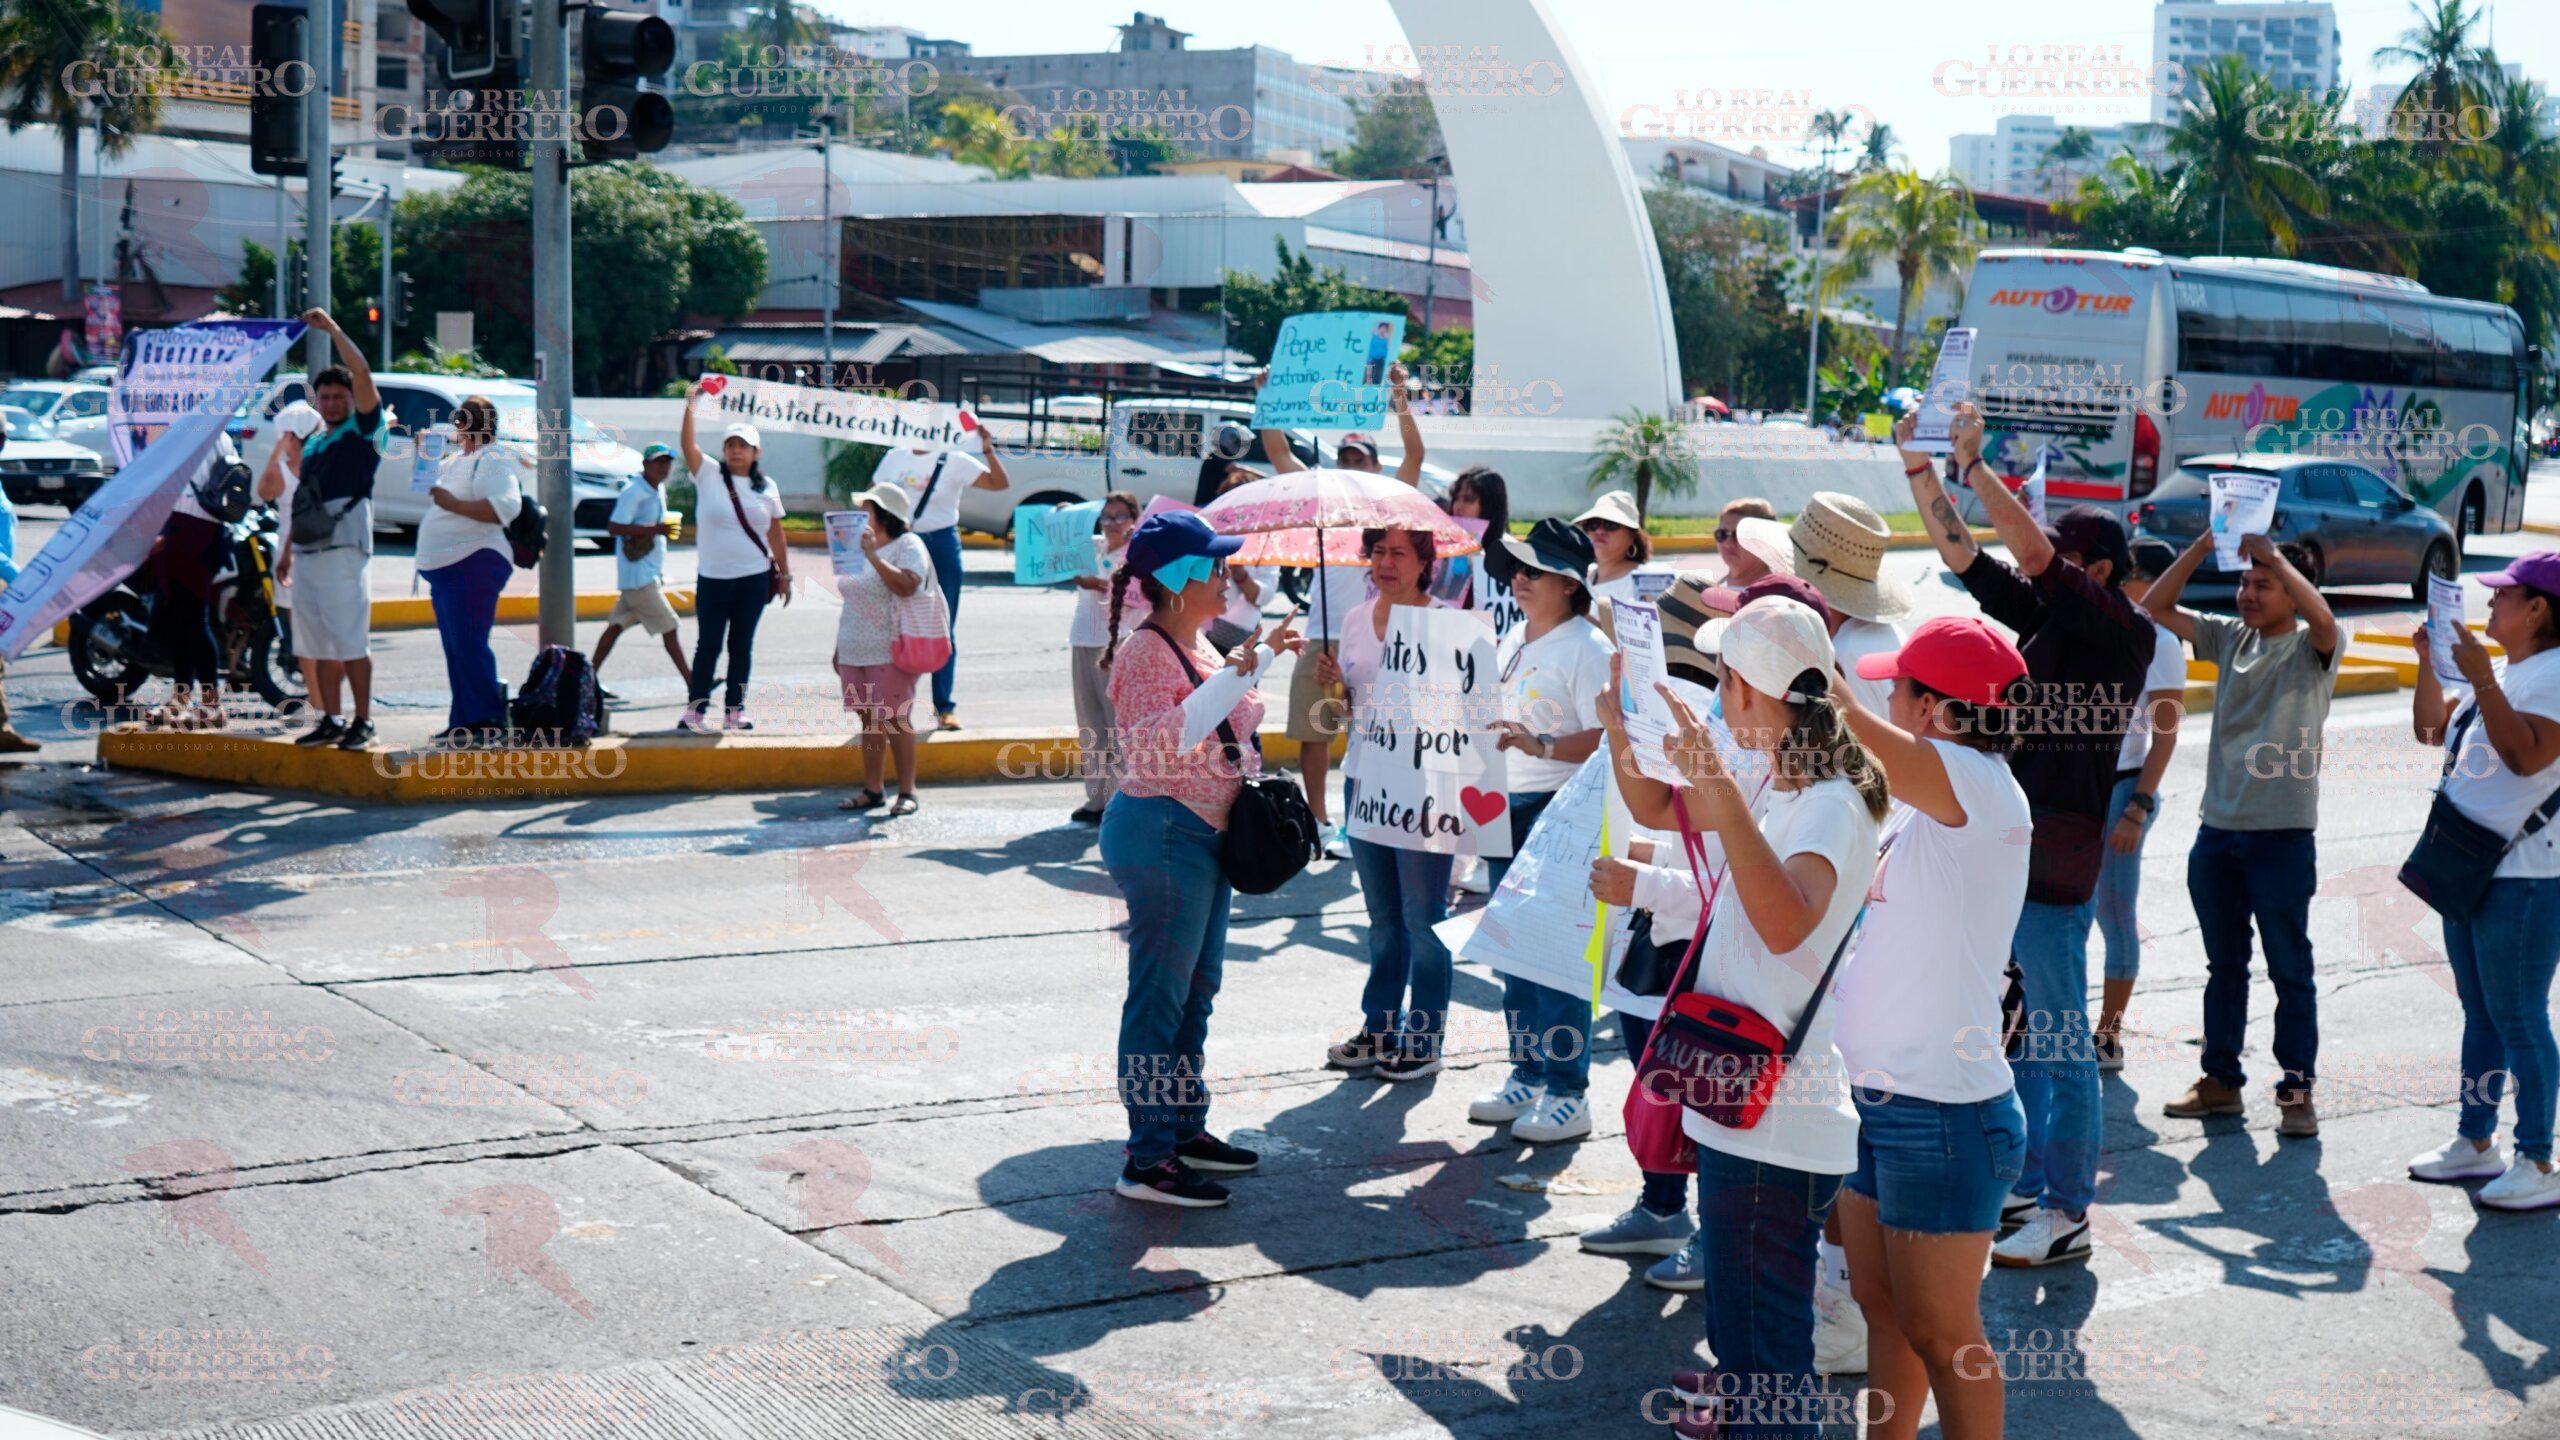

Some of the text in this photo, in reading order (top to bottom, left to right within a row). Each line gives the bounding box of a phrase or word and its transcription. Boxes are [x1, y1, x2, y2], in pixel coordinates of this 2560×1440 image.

[1989, 284, 2134, 315] AUTOTUR
[1281, 325, 1364, 366] Peque te
[1334, 364, 1354, 384] te
[2204, 381, 2300, 430] AUTOTUR
[1455, 648, 1475, 694] y
[1414, 726, 1469, 770] por
